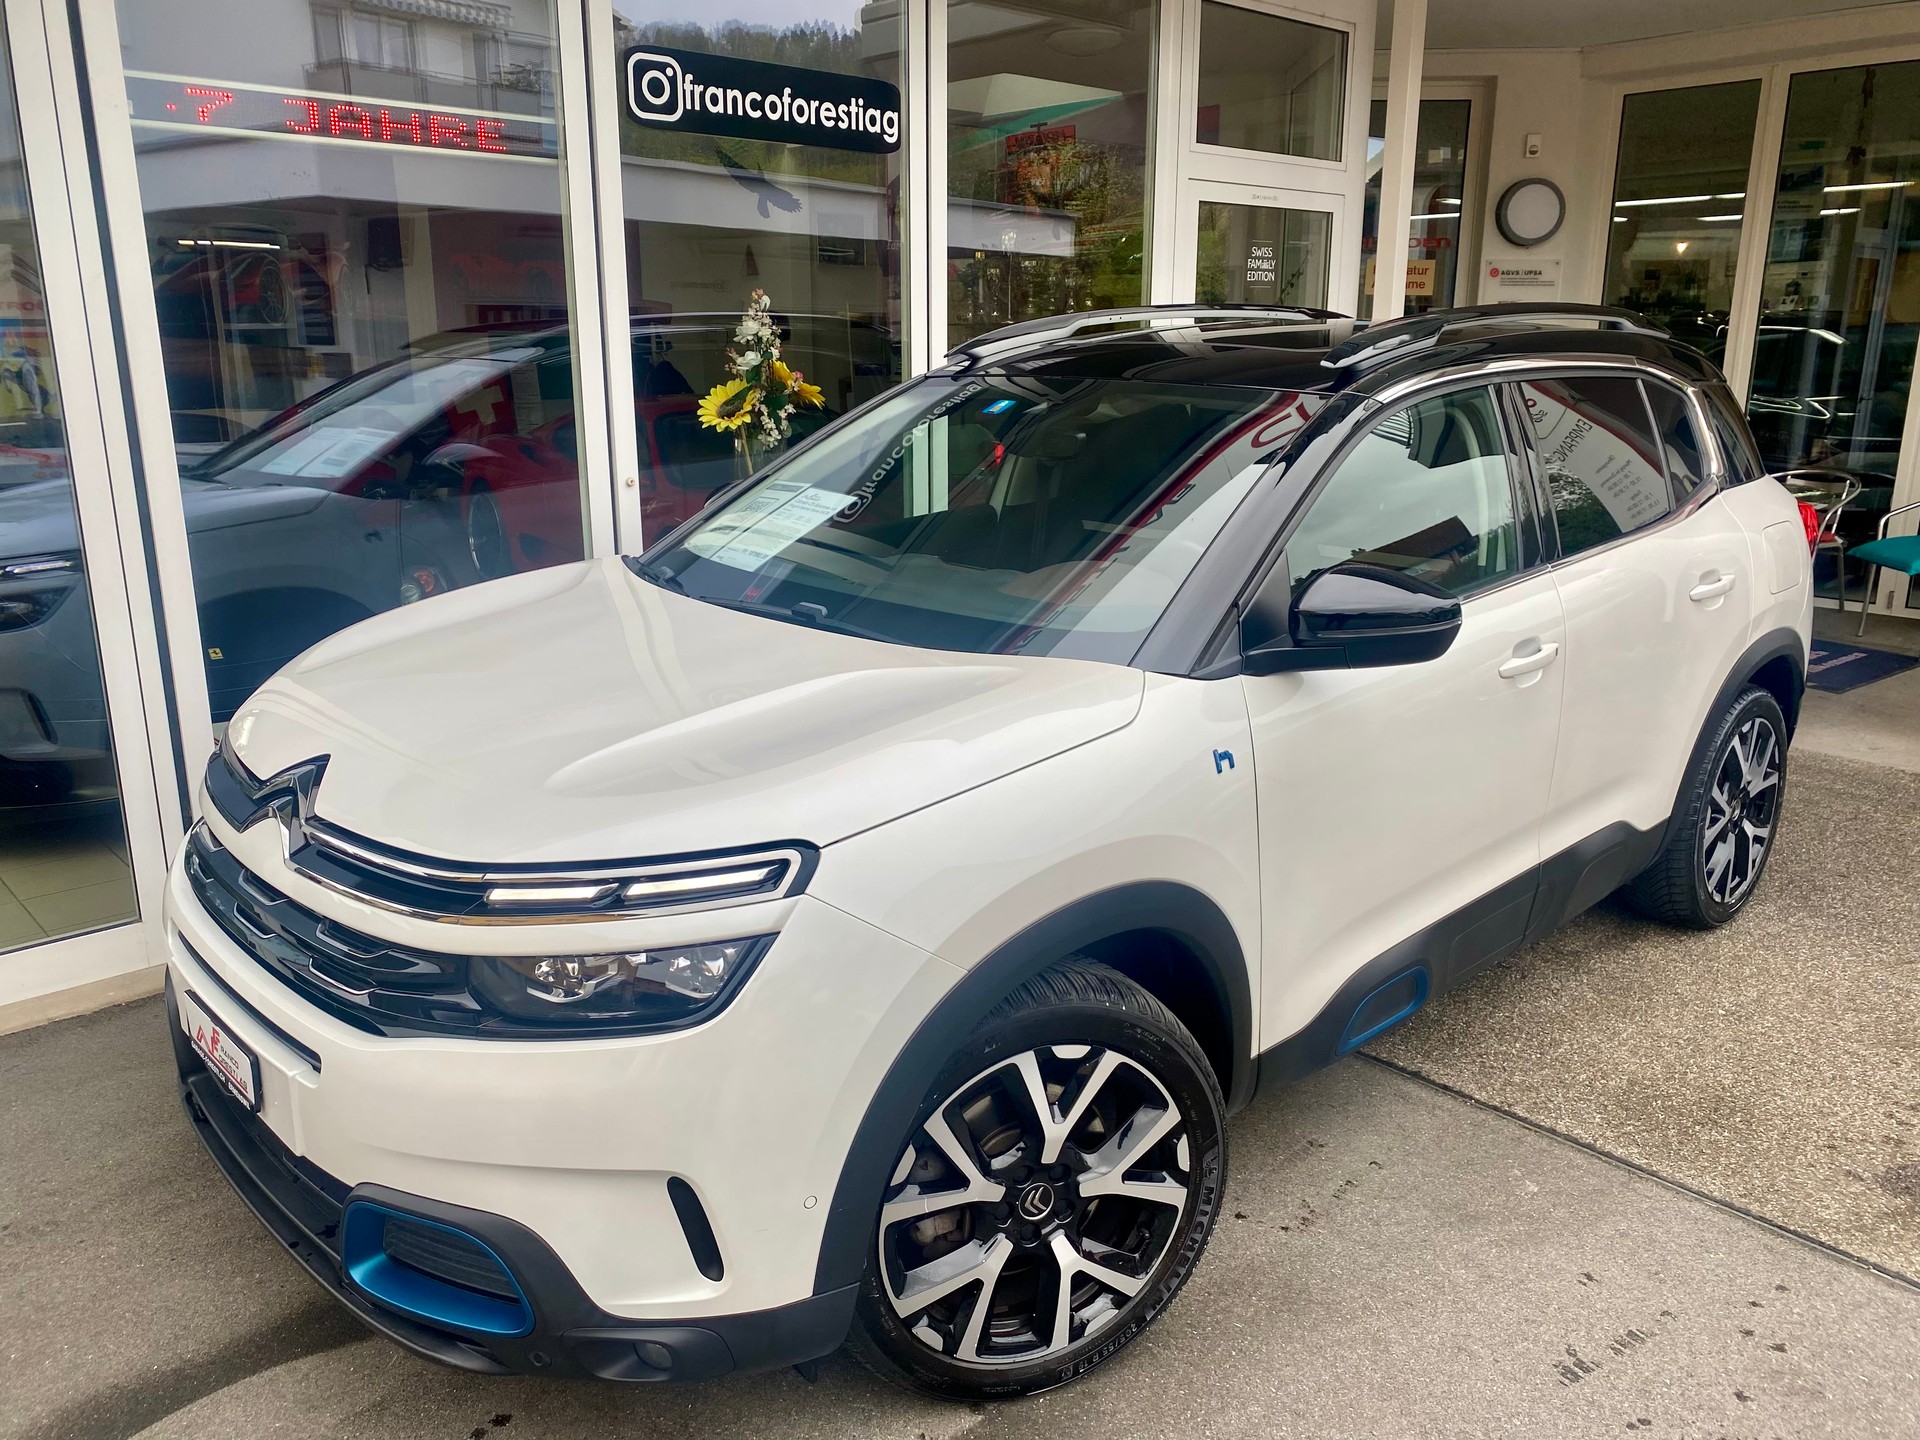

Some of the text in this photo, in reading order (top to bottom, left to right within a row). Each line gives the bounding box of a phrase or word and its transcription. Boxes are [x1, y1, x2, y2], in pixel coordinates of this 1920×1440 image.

[683, 73, 900, 144] francoforestiag
[283, 98, 508, 152] JAHRE
[1251, 246, 1273, 257] SWISS
[1246, 271, 1275, 282] EDITION
